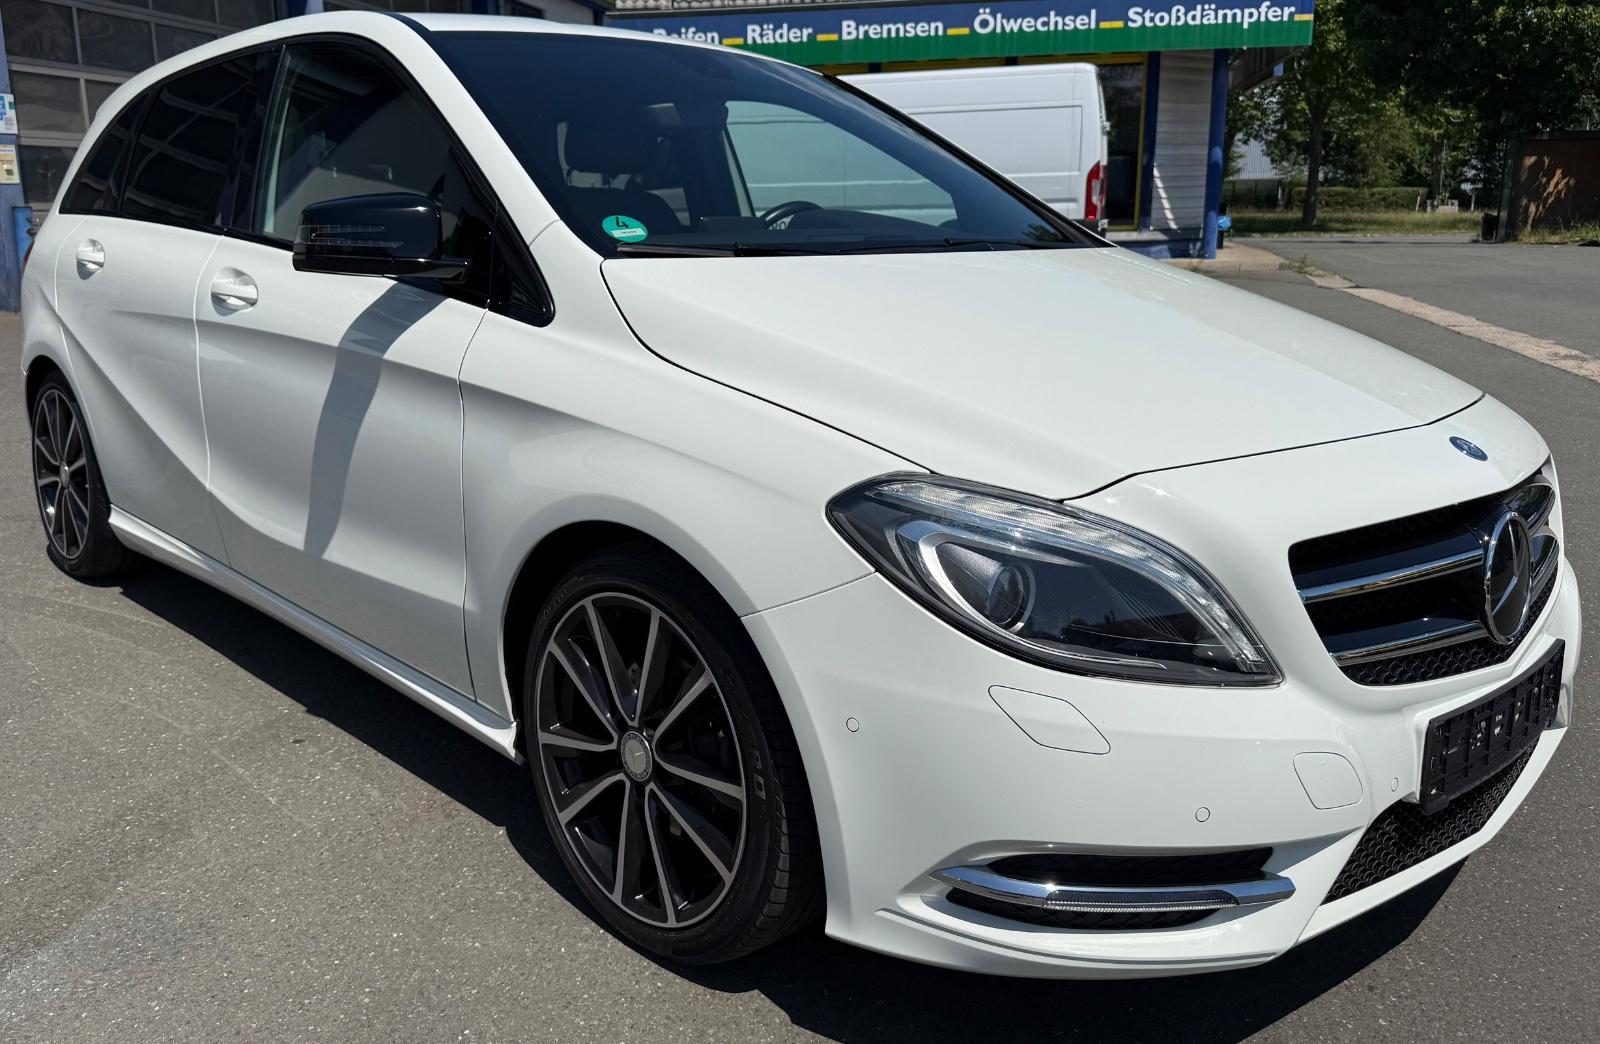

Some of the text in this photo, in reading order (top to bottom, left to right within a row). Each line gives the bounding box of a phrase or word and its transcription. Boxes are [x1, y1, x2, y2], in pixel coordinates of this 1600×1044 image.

[653, 1, 1296, 45] ifen Räder Bremsen Ölwechsel Stoßdämpfer
[615, 216, 628, 229] 4
